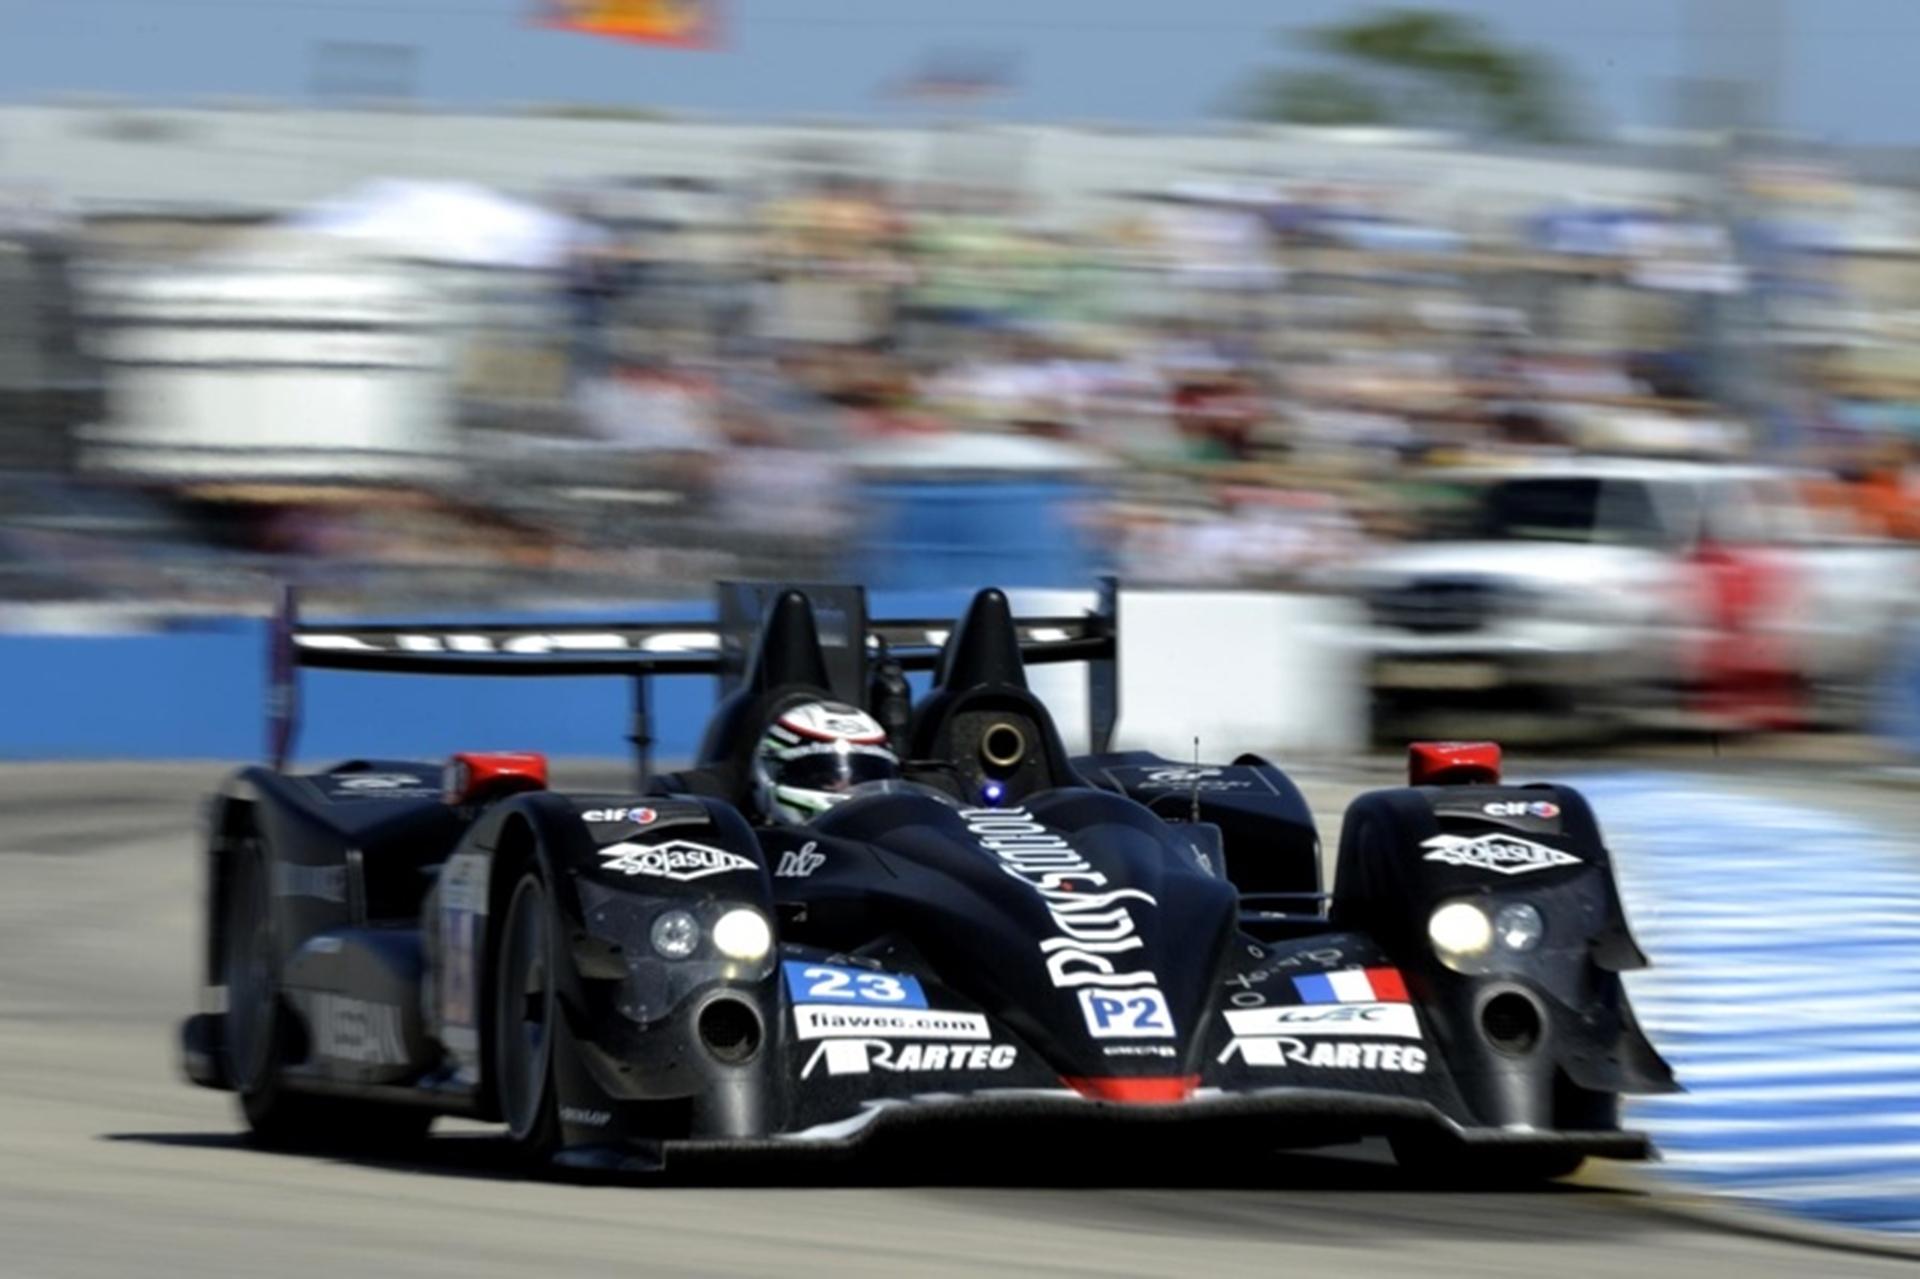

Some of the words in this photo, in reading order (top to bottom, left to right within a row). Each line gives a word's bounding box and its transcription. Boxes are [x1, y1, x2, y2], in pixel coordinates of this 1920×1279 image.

[803, 967, 906, 1001] 23
[810, 1012, 977, 1032] fiawec.com
[1089, 997, 1164, 1029] P2
